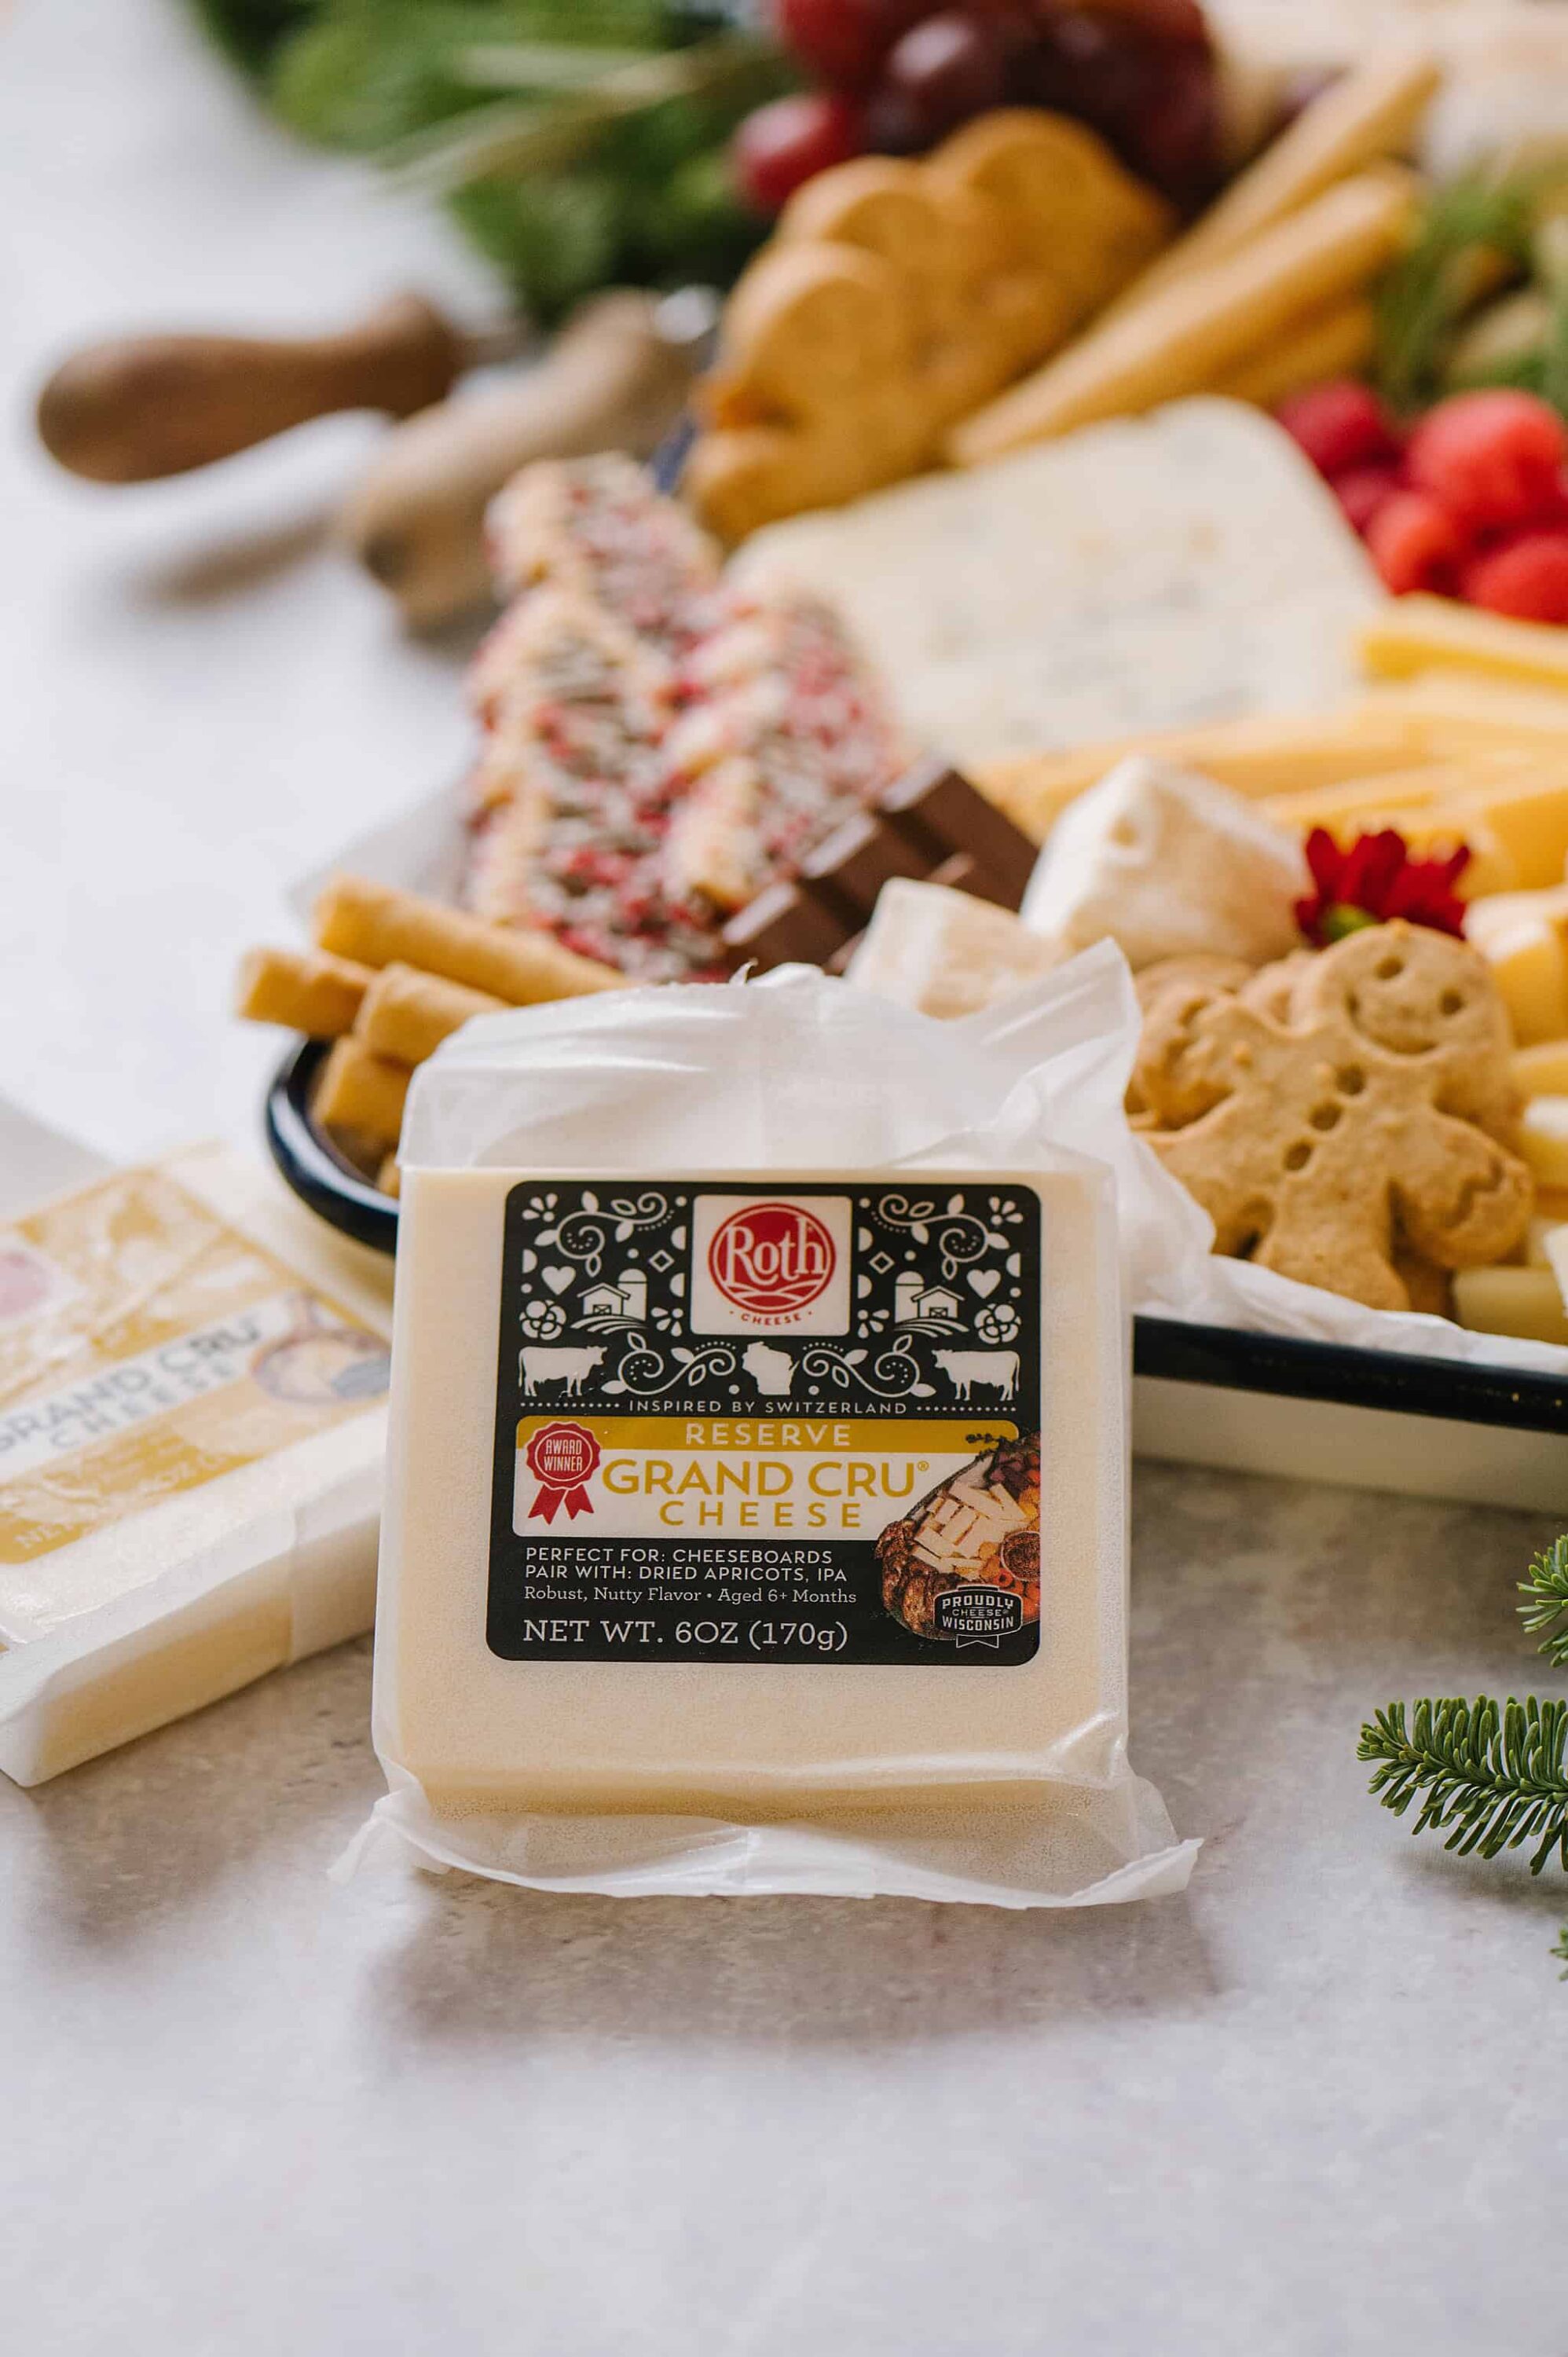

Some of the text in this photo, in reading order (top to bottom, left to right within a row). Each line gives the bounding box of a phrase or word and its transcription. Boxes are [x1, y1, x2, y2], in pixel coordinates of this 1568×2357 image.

[726, 1215, 826, 1285] Roth
[741, 1313, 802, 1325] CHEESE
[629, 1400, 907, 1414] INSPIRED BY SWITZERLAND
[685, 1422, 851, 1446] RESERVE
[545, 1439, 582, 1455] AWARD
[544, 1456, 583, 1472] WINNER
[602, 1460, 793, 1496] GRAND
[658, 1500, 861, 1527] CHEESE
[526, 1547, 833, 1564] PERFECT FOR: CHEESEBOARDS
[525, 1564, 848, 1583] PAIR WITH: DRIED APRICOTS, IPA
[524, 1585, 857, 1605] Robust, Nutty Flavor Aged 6+ Months
[943, 1595, 1013, 1609] PROUDLY
[943, 1615, 1013, 1631] WISCONSIN
[523, 1619, 848, 1651] NET WT. 6OZ (170g)
